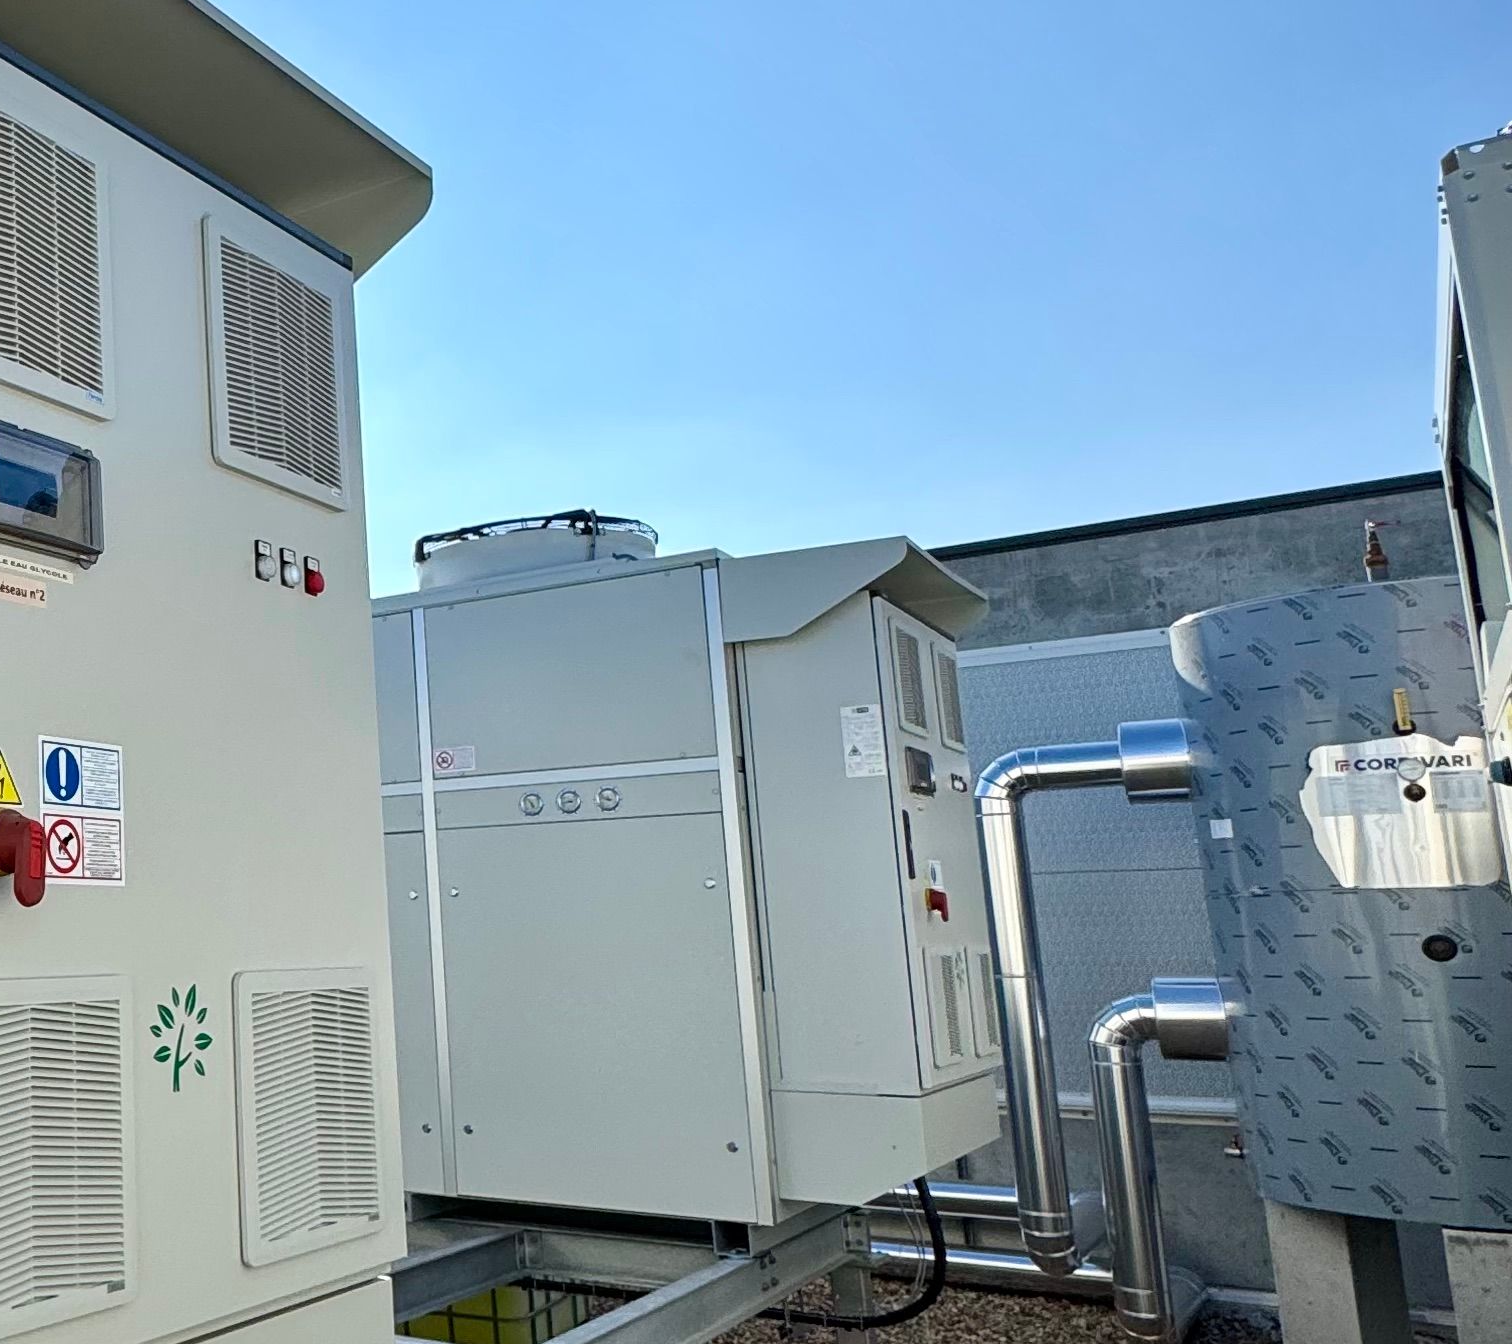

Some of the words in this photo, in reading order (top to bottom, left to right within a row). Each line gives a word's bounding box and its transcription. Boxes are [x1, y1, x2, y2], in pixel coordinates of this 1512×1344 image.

[10, 560, 28, 570] EAU
[29, 588, 46, 602] n°2
[1353, 754, 1472, 772] CORVARI
